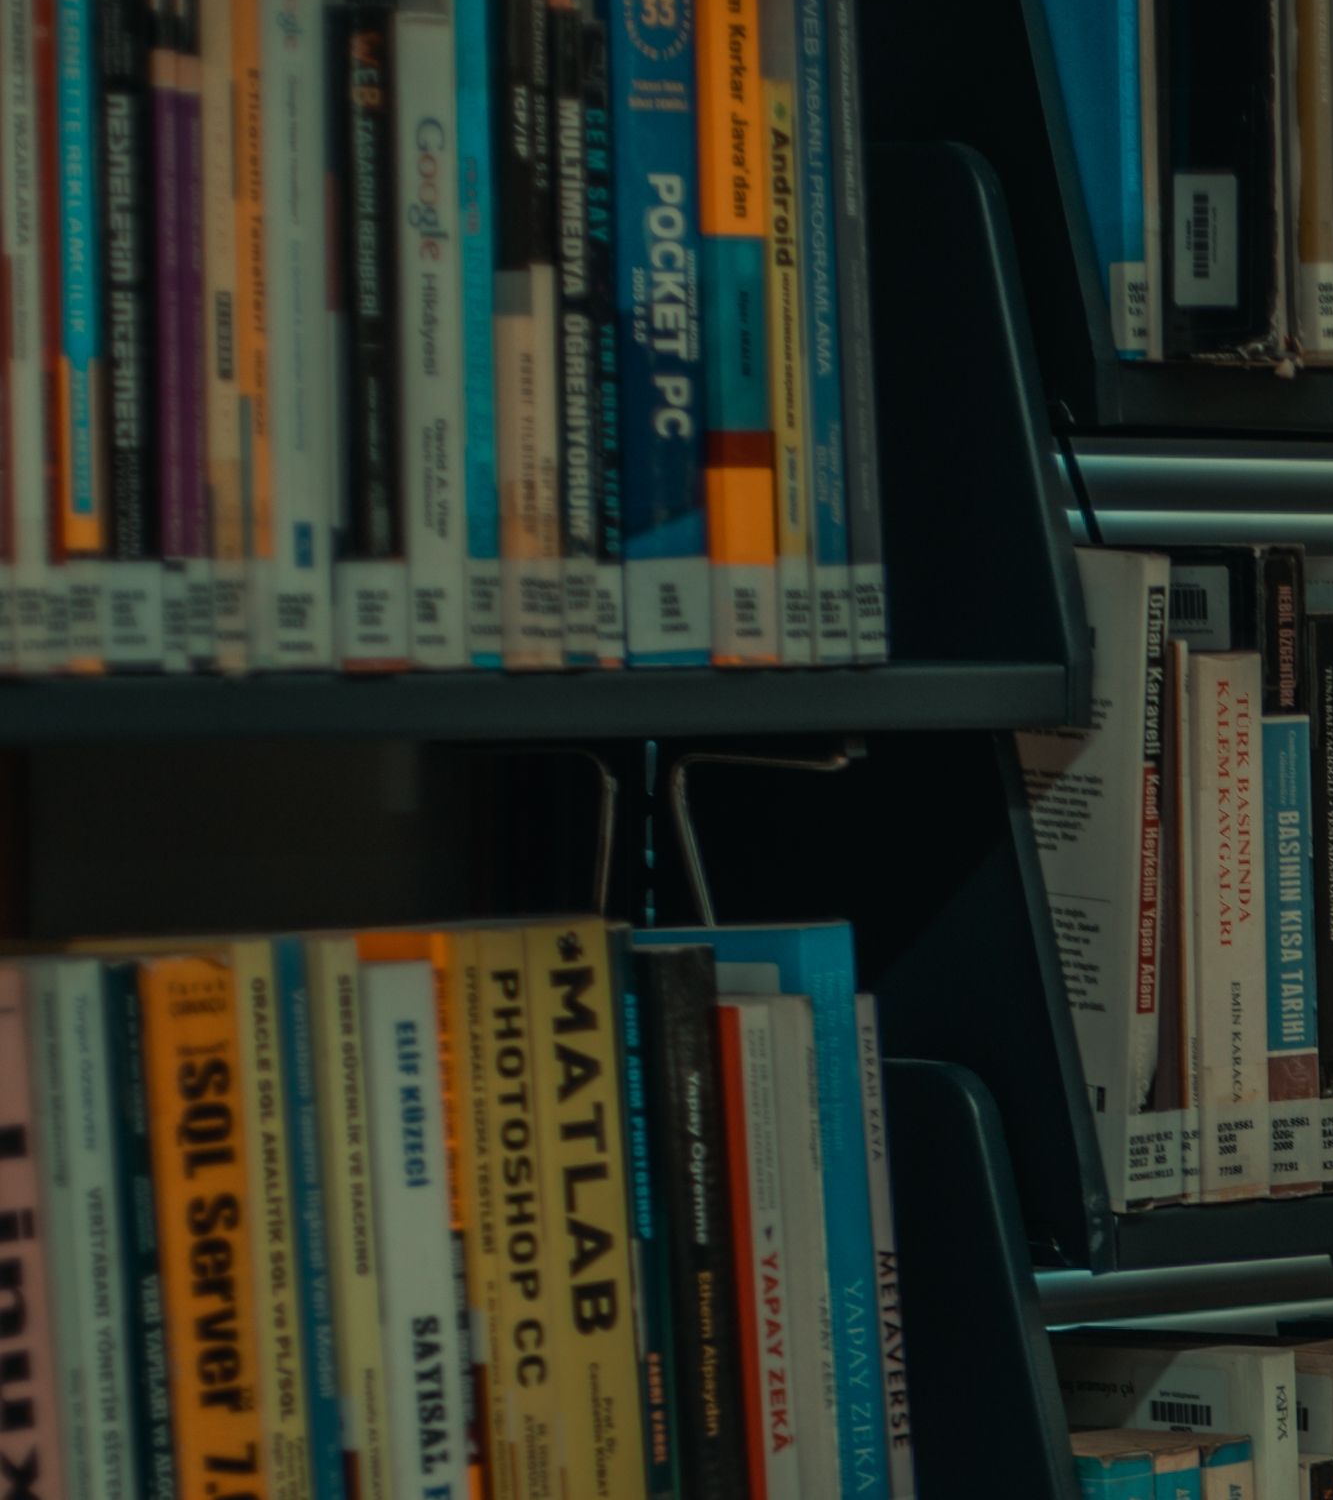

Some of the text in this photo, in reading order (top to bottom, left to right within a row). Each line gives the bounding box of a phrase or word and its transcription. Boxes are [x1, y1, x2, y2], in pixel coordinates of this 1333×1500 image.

[728, 24, 748, 102] Korkar
[407, 118, 446, 260] Google
[772, 129, 794, 267] Android
[559, 102, 596, 537] MULTİMEDYA ÖĞRENİYORUM
[648, 173, 692, 440] POCKET PC
[1217, 680, 1234, 947] KALEM KAVGALARI
[1236, 694, 1253, 923] TÜRK BASININDA
[1276, 811, 1303, 902] BASININ
[1280, 969, 1306, 1041] TARİHİ
[175, 1057, 236, 1179] SQL
[490, 970, 549, 1388] PHOTOSHOP CC
[548, 966, 620, 1337] MATLAB
[187, 1195, 247, 1414] Server
[760, 1253, 787, 1358] YAPAY
[843, 1279, 870, 1394] YAPAY
[877, 1251, 912, 1450] METAVERSE
[412, 1316, 445, 1474] SAYISAL
